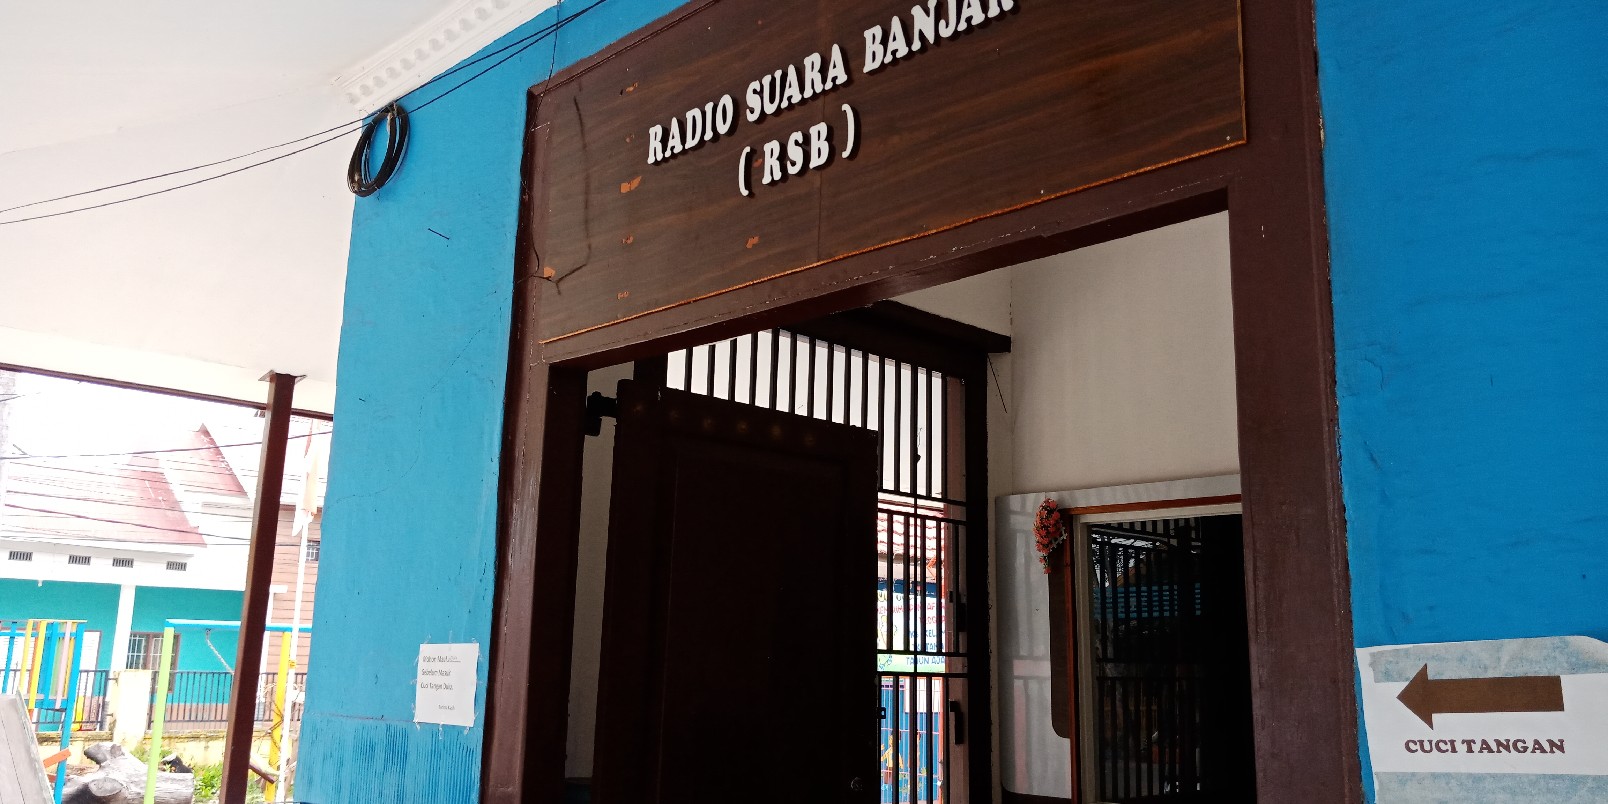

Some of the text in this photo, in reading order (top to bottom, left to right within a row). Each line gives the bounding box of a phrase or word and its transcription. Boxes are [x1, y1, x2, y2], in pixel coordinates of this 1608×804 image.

[647, 94, 734, 165] RADIO
[745, 43, 849, 123] SUARA
[1404, 738, 1566, 754] CUCI TANGAN
